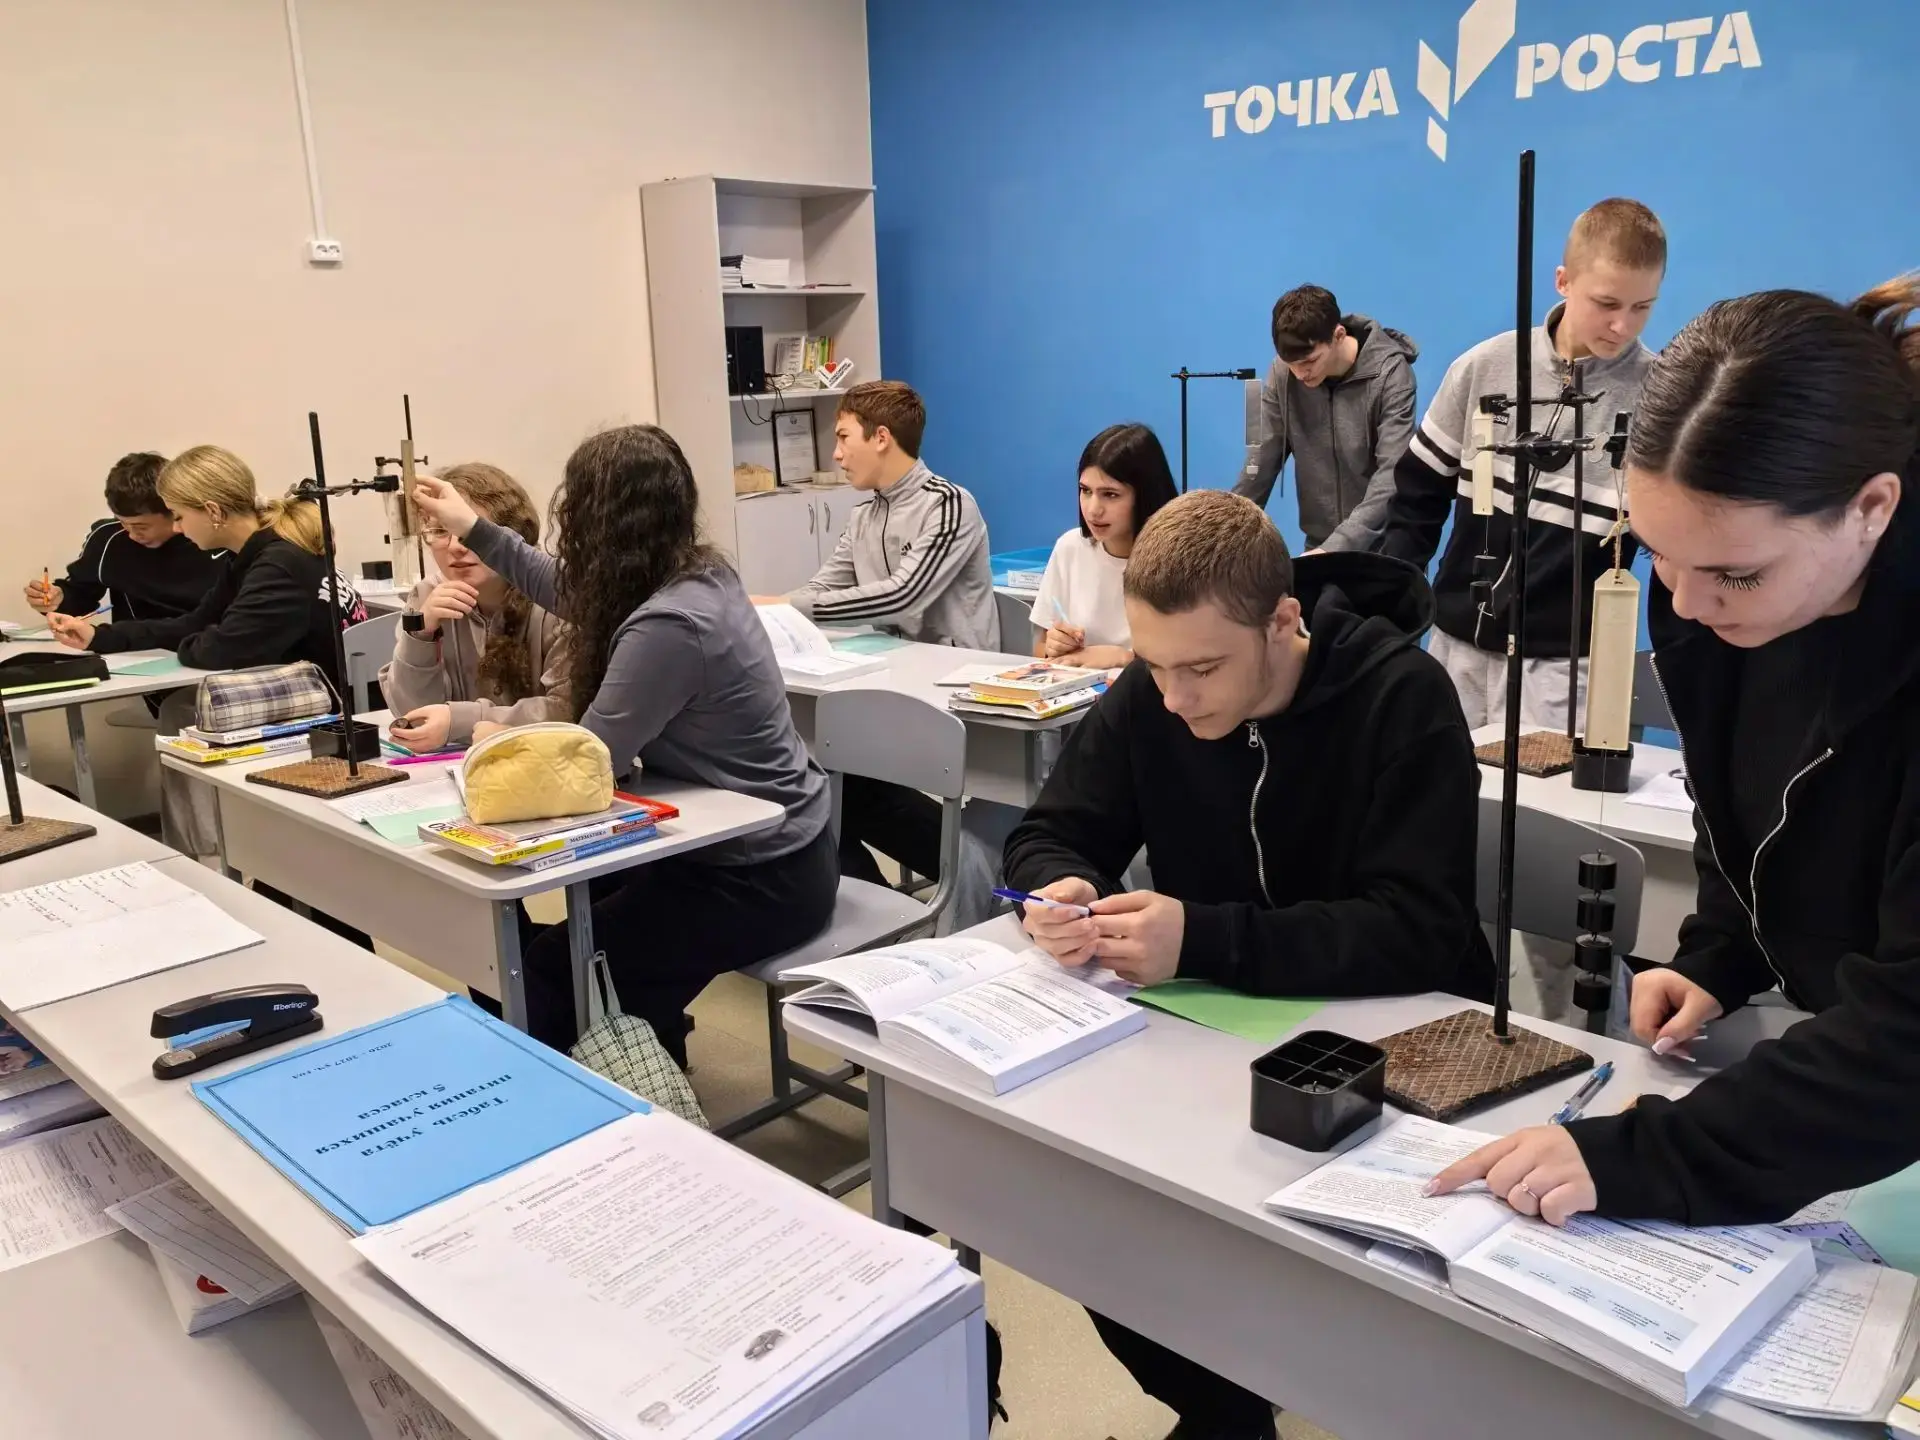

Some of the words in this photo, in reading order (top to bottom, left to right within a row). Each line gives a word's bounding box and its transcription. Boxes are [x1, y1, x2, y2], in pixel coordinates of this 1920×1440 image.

[1204, 68, 1399, 138] ТОЧКА
[1516, 11, 1762, 98] РОСТА
[570, 830, 606, 843] МАТЕМАТИКА
[279, 1001, 308, 1011] berlingo
[428, 1074, 512, 1111] питания
[433, 1083, 447, 1093] 5
[357, 1090, 428, 1120] класса
[432, 1096, 508, 1127] Табель
[315, 1107, 424, 1155] учащихся
[360, 1127, 424, 1157] учёта
